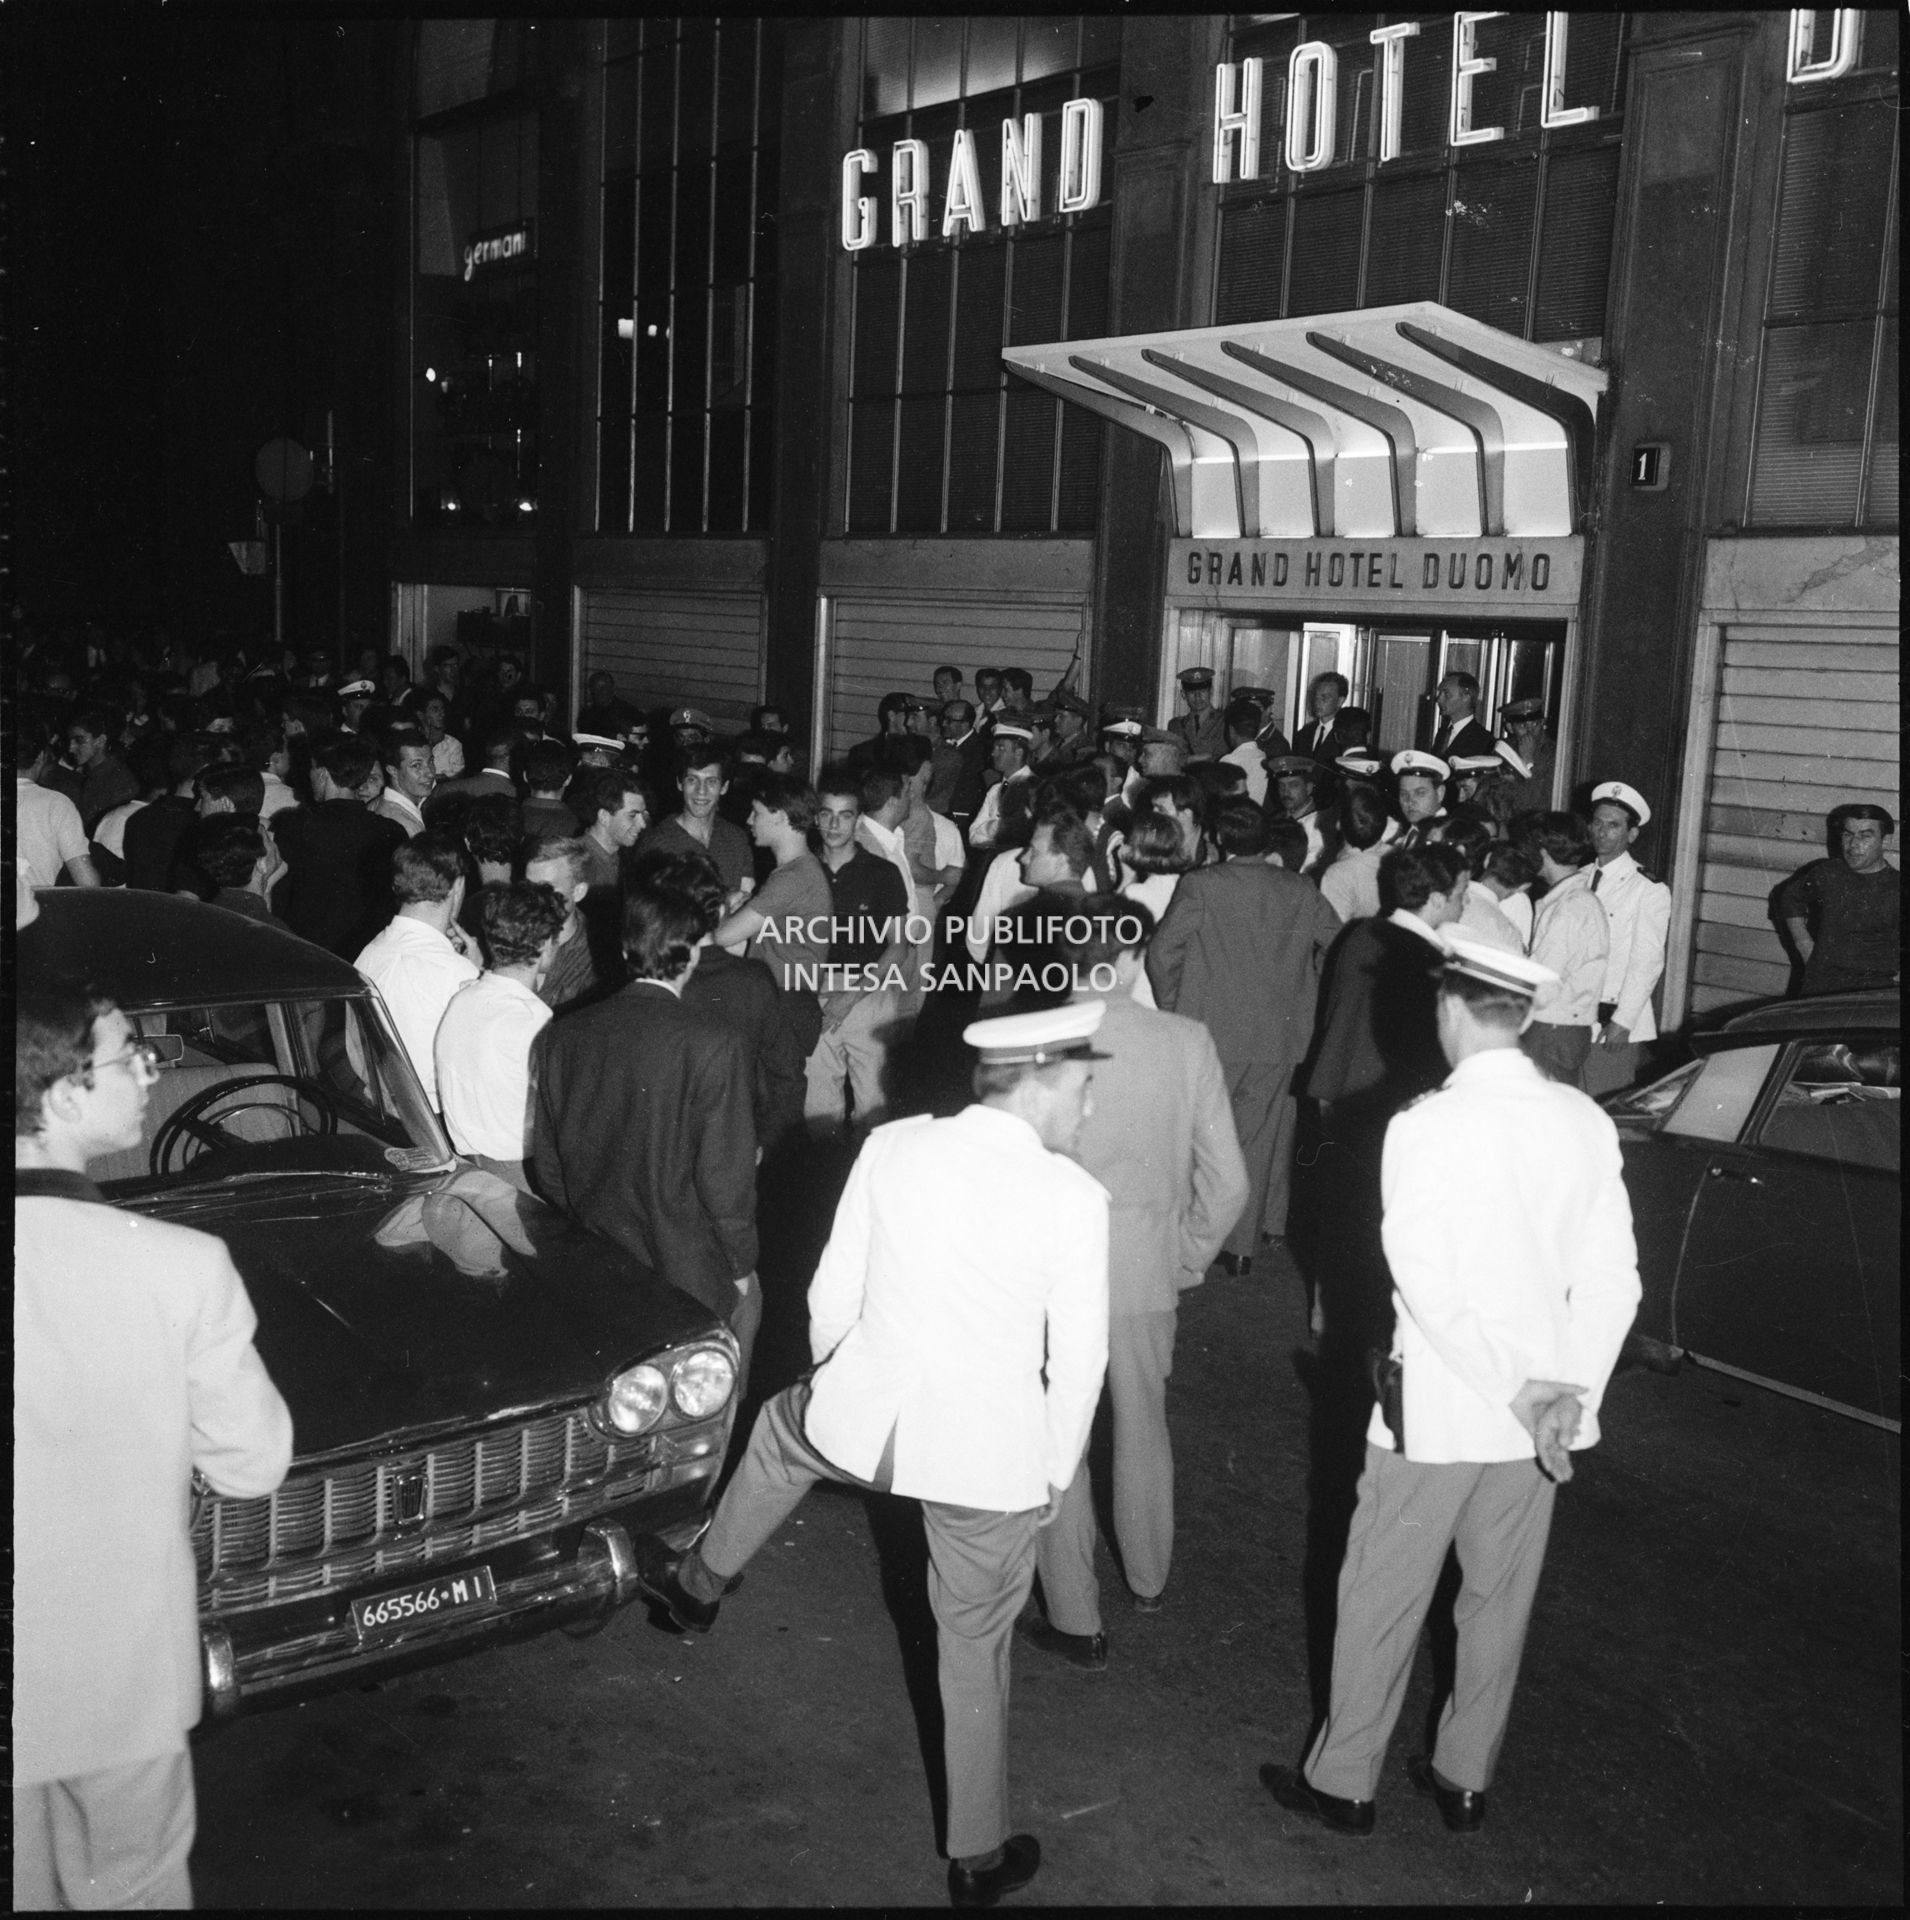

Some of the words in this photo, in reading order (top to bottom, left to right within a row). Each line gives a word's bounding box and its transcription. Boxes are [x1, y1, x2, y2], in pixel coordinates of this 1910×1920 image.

[842, 98, 1103, 250] GRAND
[1212, 11, 1600, 184] HOTEL
[1638, 452, 1647, 480] 1
[1187, 551, 1289, 587] GRAND
[1305, 551, 1404, 589] HOTEL
[1422, 552, 1551, 591] DUOMO
